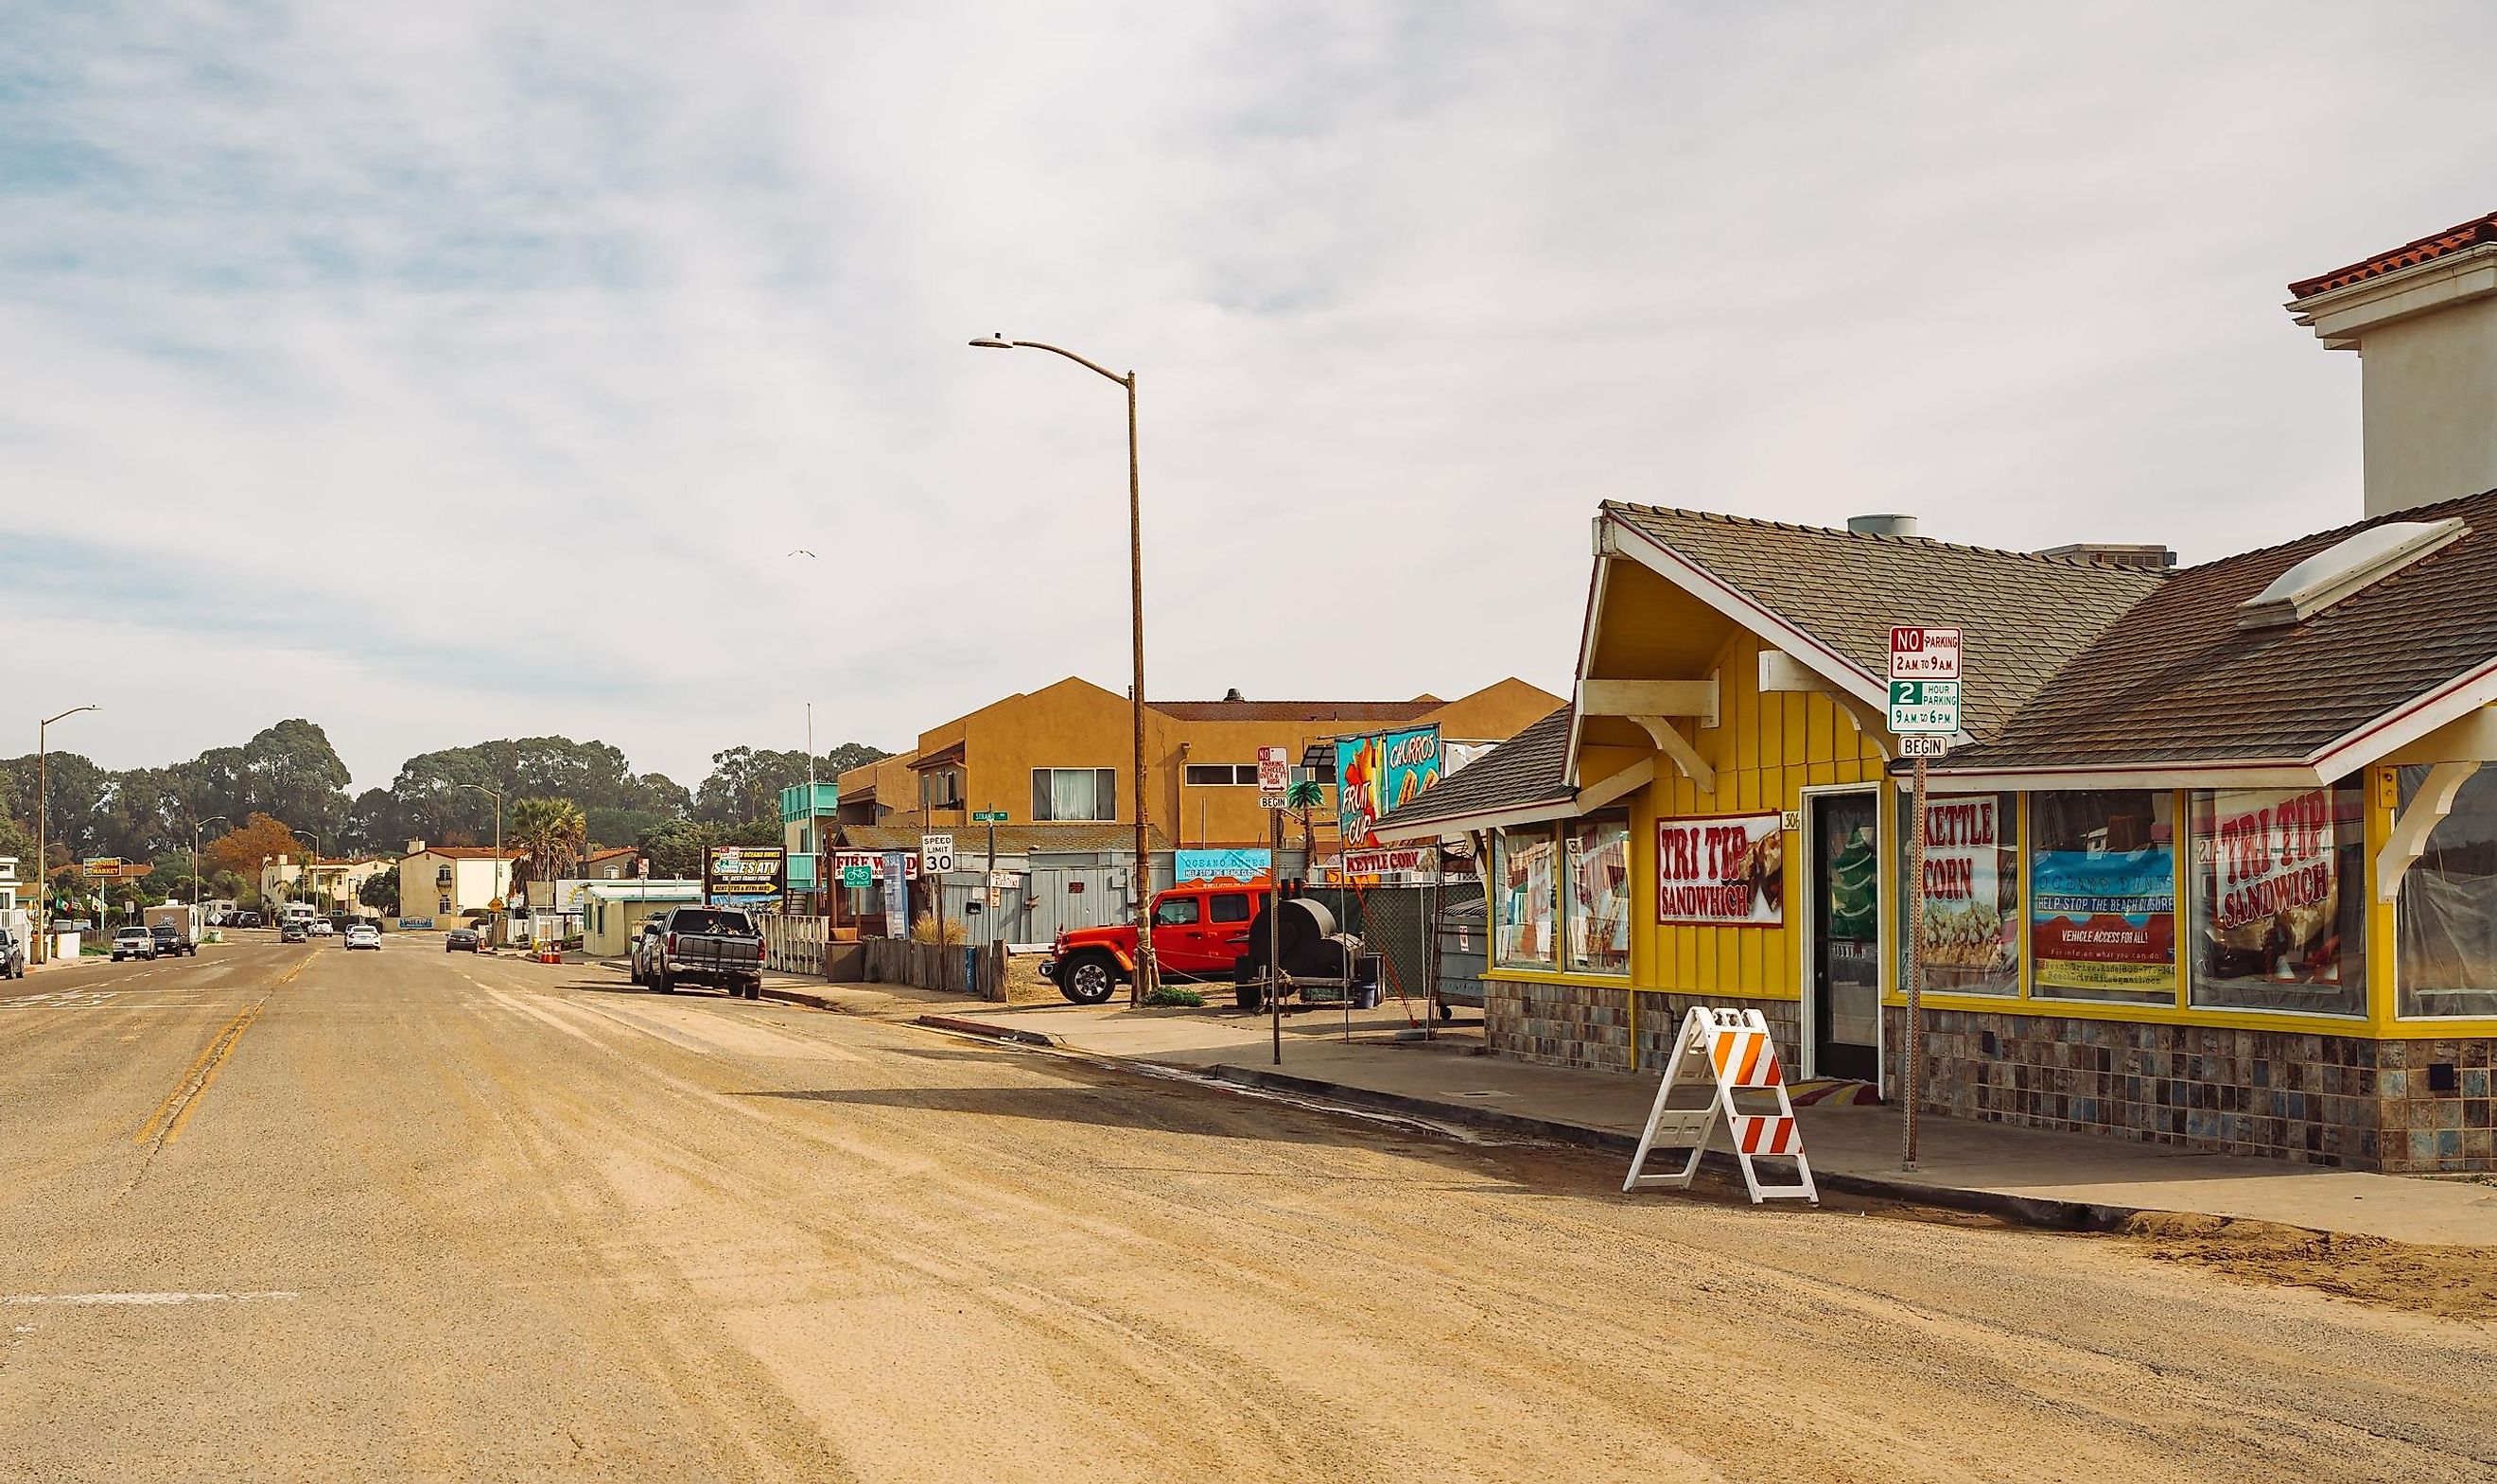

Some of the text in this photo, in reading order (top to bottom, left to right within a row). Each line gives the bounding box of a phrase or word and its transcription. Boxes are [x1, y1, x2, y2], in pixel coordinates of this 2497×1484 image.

[1897, 630, 1958, 651] NO PARKING
[1896, 655, 1904, 671] 2
[1921, 659, 1930, 669] TO
[1930, 655, 1938, 671] 9
[1899, 682, 1950, 704] 2 HOUR
[1923, 695, 1957, 706] PARKING
[1895, 709, 1903, 725] 9
[1930, 709, 1937, 724] 6
[1259, 749, 1269, 760] NO
[1389, 733, 1436, 769] CHURROS
[1905, 739, 1942, 754] BEGIN
[1262, 797, 1285, 807] BEGIN
[1341, 781, 1371, 814] FRUIT
[1784, 812, 1800, 828] 306
[1924, 802, 1994, 847] KETTLE
[1347, 814, 1371, 846] CUP
[2222, 789, 2328, 885] TRI TIP
[1661, 827, 1701, 881] TRI
[1704, 826, 1748, 881] TIP
[756, 861, 779, 874] ATV
[835, 856, 869, 869] FIRE
[872, 856, 917, 870] WD
[926, 855, 952, 870] 30
[1185, 859, 1226, 867] OCEANO
[1346, 851, 1420, 873] KETTLE CORN
[1923, 857, 1973, 901] CORN
[2038, 875, 2110, 891] OCEANO
[1662, 884, 1749, 917] SANDWHICH
[2224, 862, 2330, 929] SANDWICH
[2038, 897, 2174, 912] HELP STOP THE BEACH CLOSURE
[2062, 930, 2148, 944] VEHICLE ACCESS FOR ALL!
[2096, 951, 2114, 959] what
